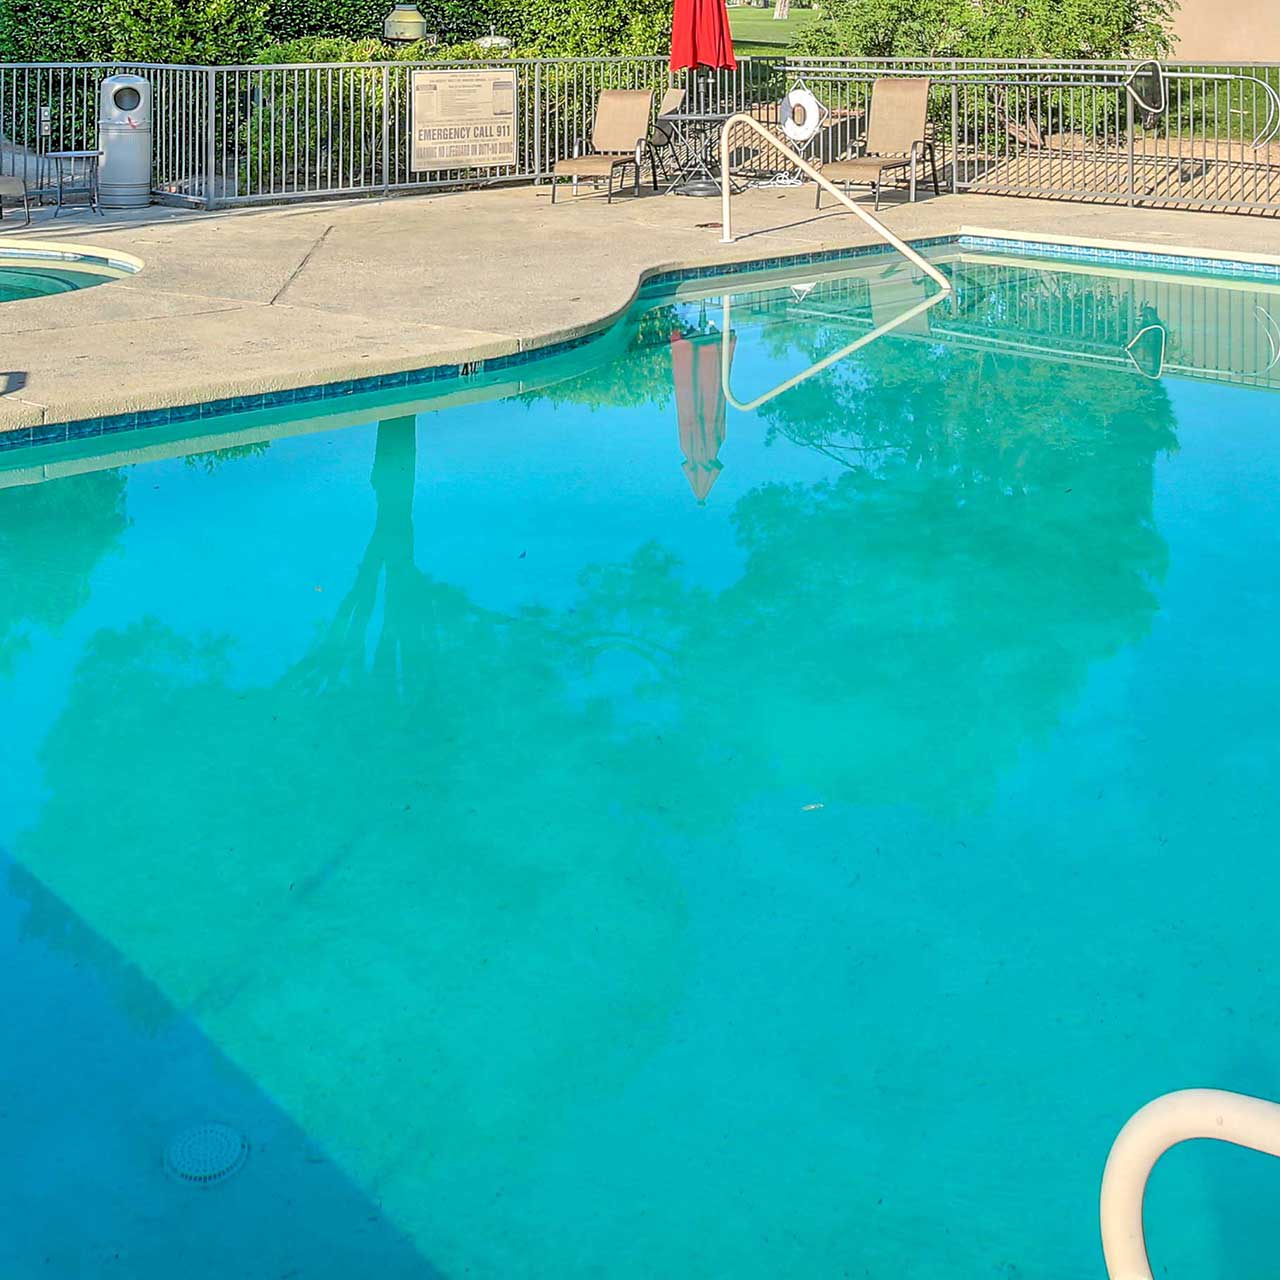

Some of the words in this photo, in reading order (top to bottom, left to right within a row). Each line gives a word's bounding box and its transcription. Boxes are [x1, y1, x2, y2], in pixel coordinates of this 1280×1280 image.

[418, 127, 471, 141] EMERGENCY
[473, 126, 494, 138] CALL
[496, 125, 510, 137] 911
